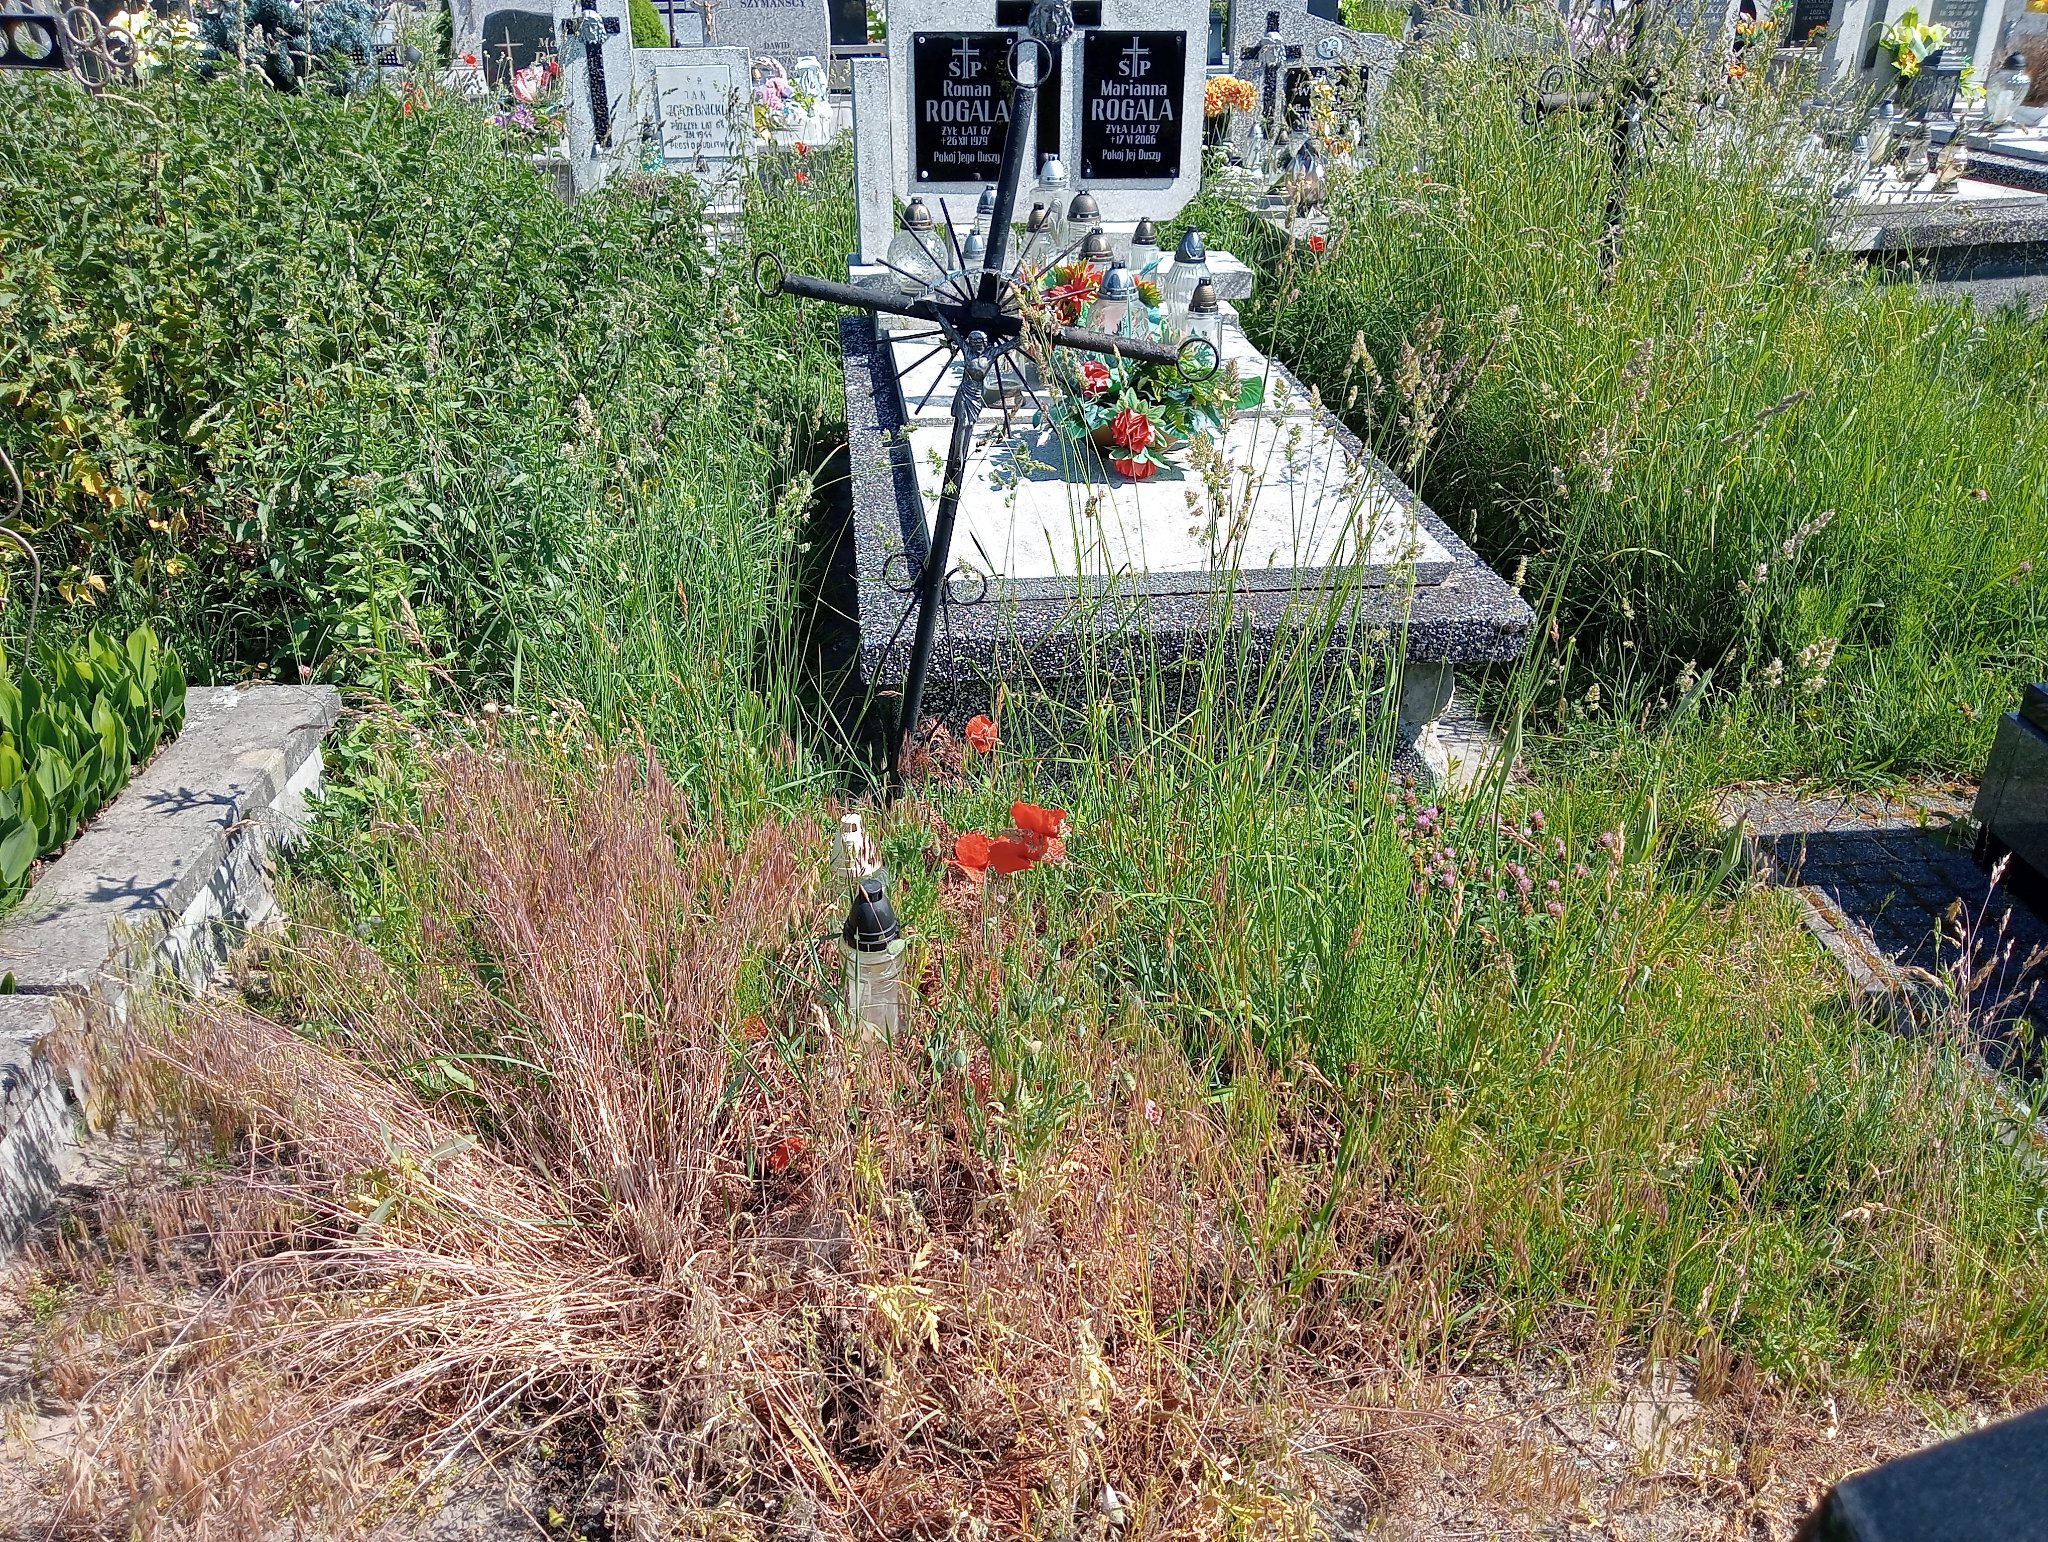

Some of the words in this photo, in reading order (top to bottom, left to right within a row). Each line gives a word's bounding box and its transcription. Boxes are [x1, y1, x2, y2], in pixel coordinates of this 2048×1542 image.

[764, 41, 790, 50] DAWID
[943, 79, 992, 97] Roman
[1100, 79, 1168, 96] Marianna
[684, 90, 706, 101] JAN
[926, 99, 1010, 122] ROGALA
[1091, 98, 1174, 121] ROGALA
[961, 126, 978, 136] LAT
[980, 126, 992, 136] 67
[1130, 124, 1147, 134] LAT
[1149, 124, 1161, 134] 97
[970, 136, 988, 146] 1979
[1135, 135, 1157, 145] 2006
[933, 150, 956, 164] Pokój
[957, 150, 975, 165] Jego
[977, 150, 1001, 165] Duszy
[1102, 148, 1124, 162] Pokój
[1125, 148, 1137, 163] Jej
[1138, 148, 1162, 163] Duszy
